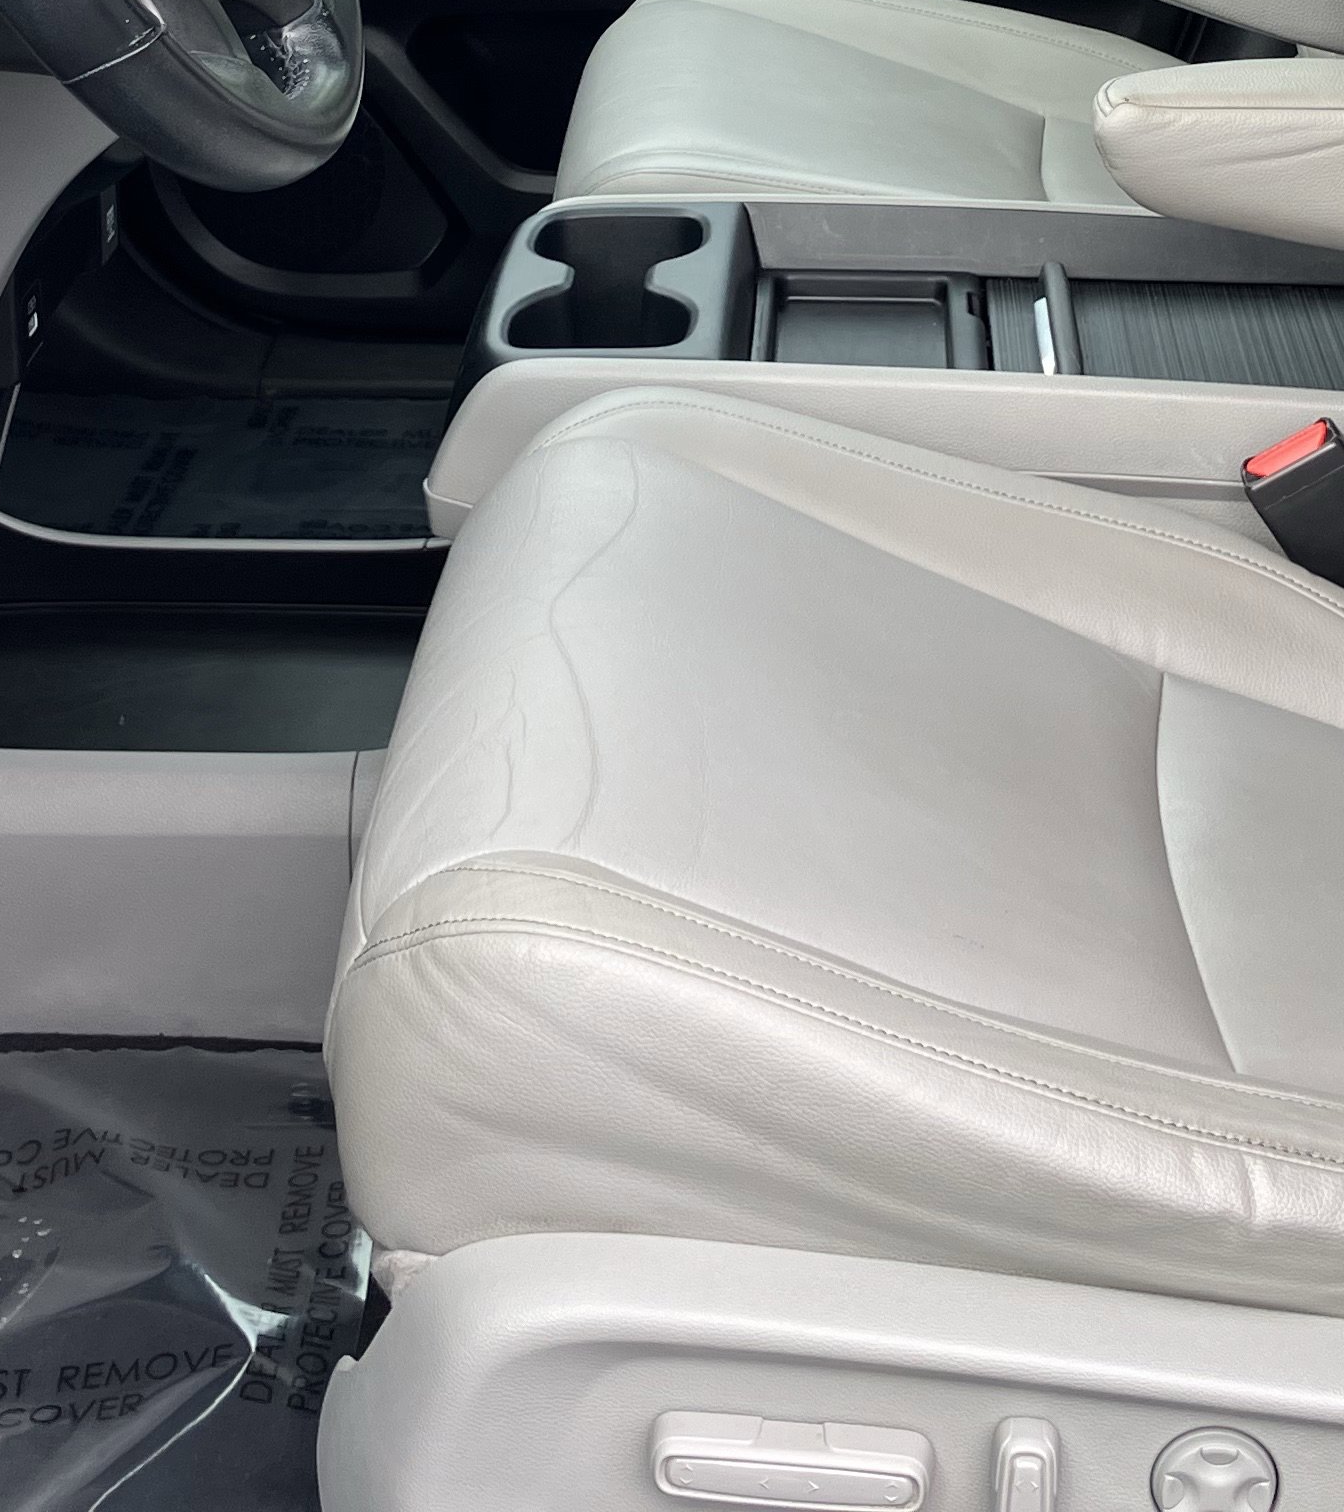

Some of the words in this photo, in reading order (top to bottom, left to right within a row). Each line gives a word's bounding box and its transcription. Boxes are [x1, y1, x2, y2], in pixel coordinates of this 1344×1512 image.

[11, 1147, 106, 1194] MUST
[52, 1127, 275, 1167] PROTECTIVE
[131, 1148, 271, 1189] DEALER
[278, 1144, 326, 1236] REMOVE
[266, 1247, 306, 1297] MUST
[286, 1267, 348, 1415] PROTECTIVE
[57, 1343, 236, 1393] REMOVE
